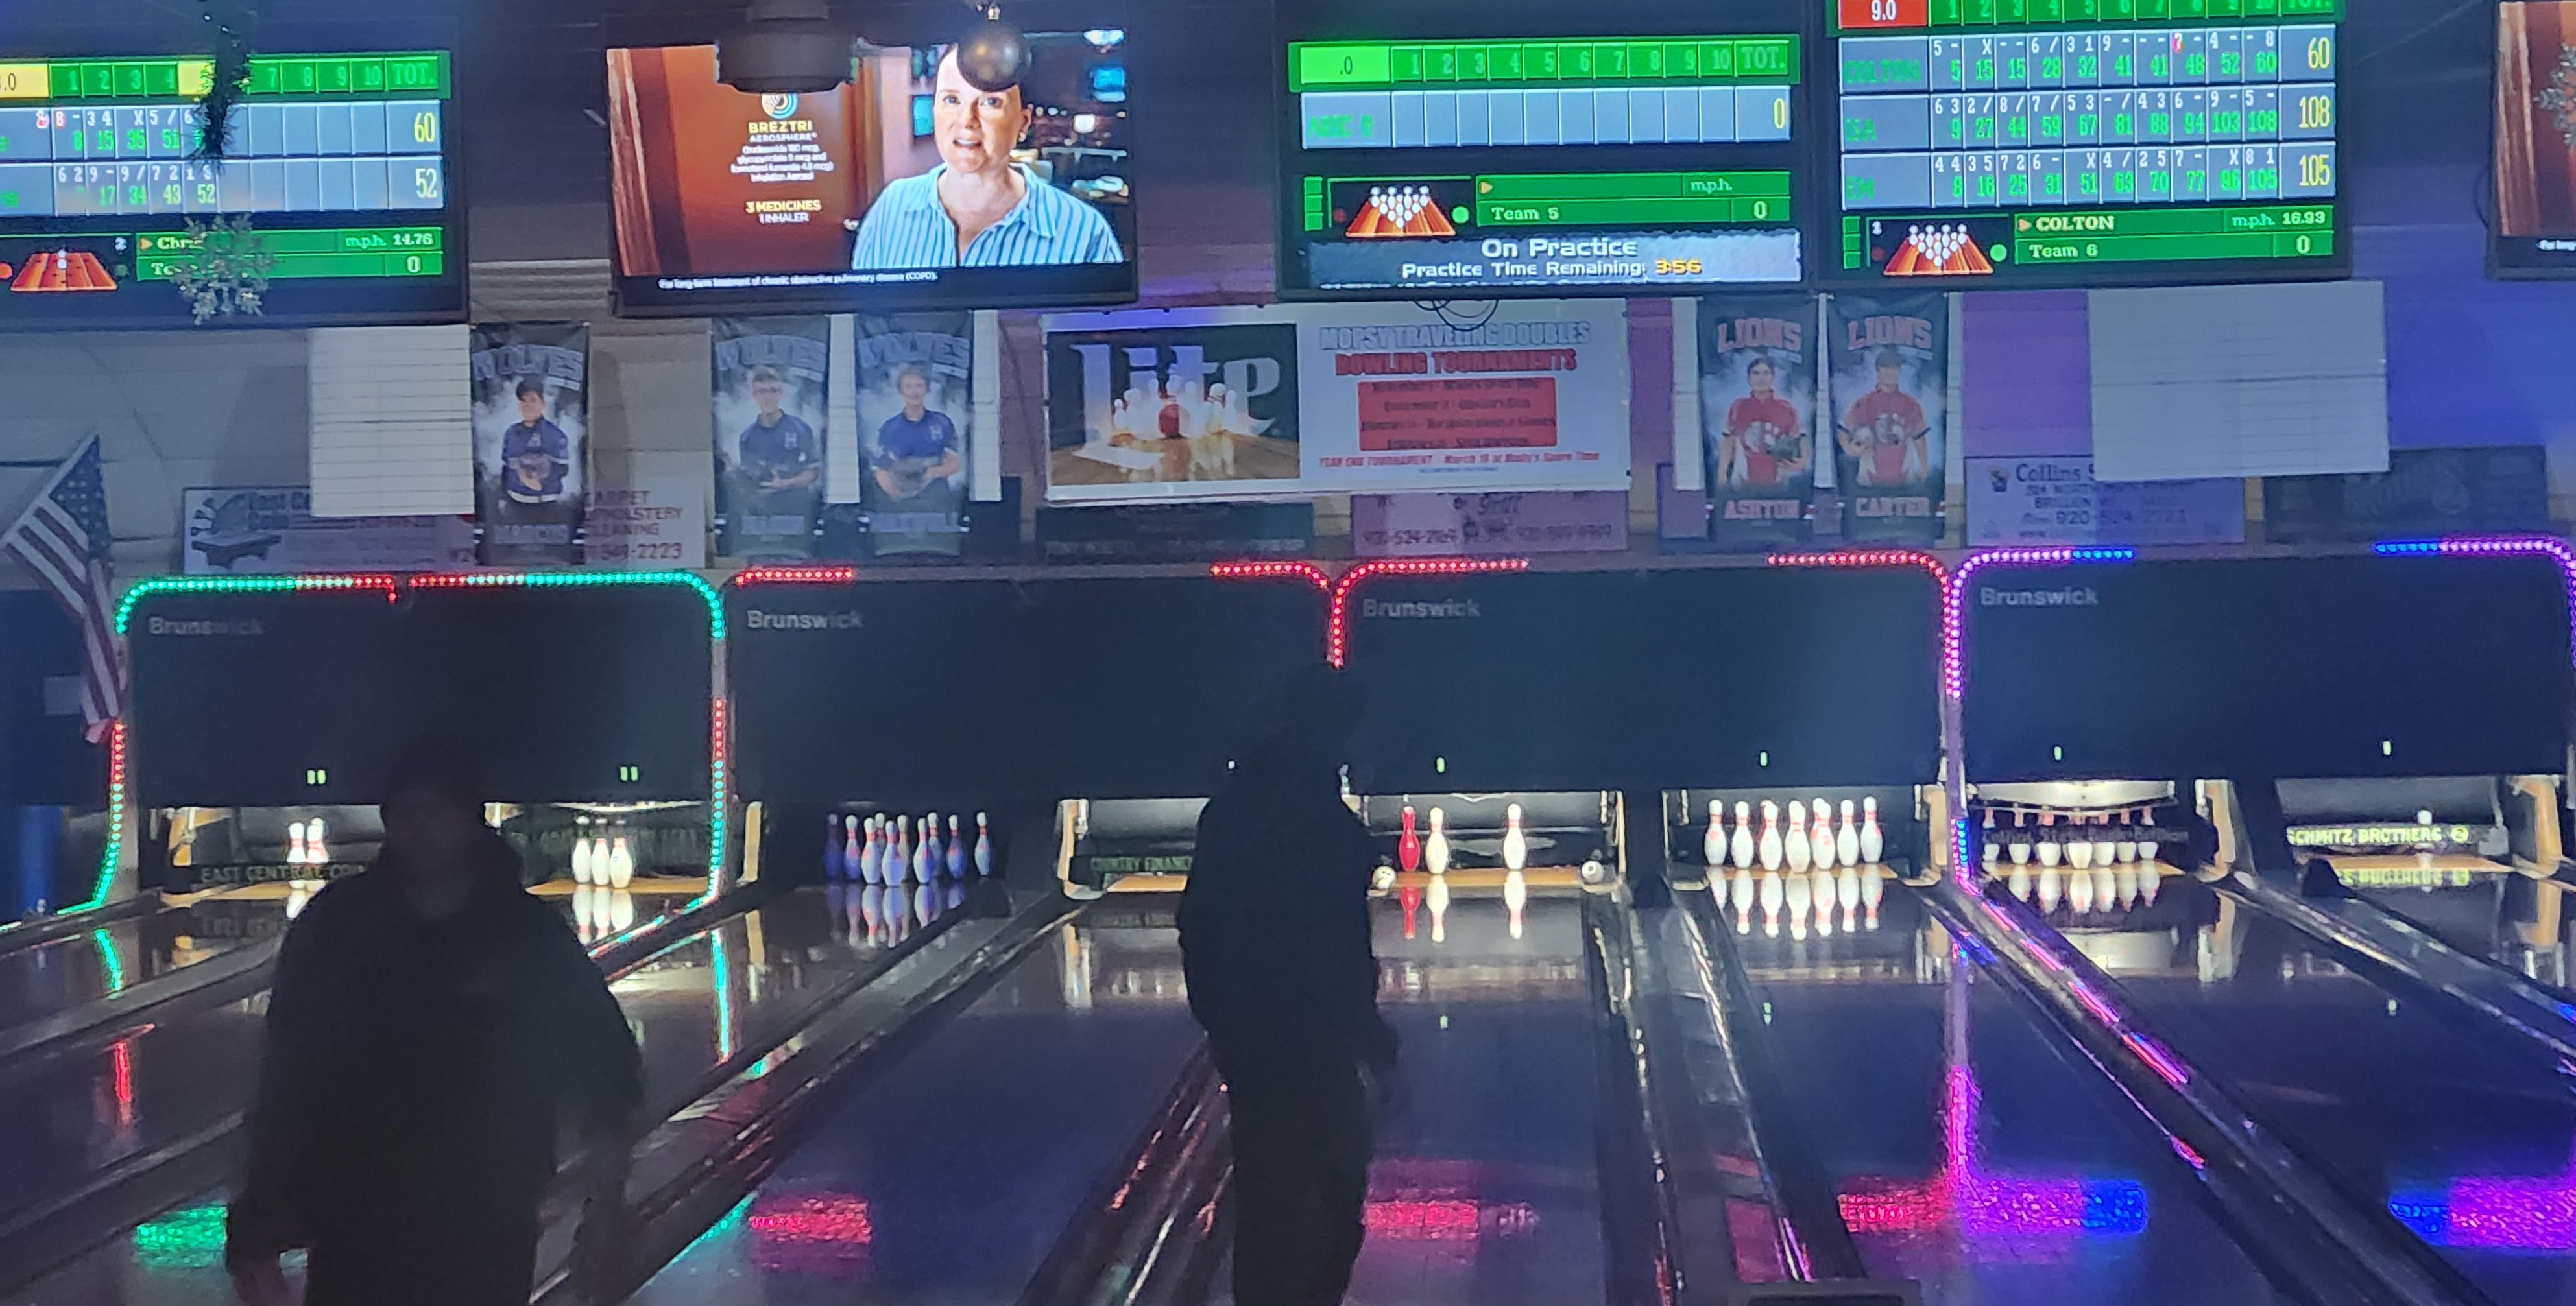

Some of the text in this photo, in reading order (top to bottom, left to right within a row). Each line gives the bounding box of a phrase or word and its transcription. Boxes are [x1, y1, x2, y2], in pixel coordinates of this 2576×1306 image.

[1871, 0, 1896, 21] 9.0
[1411, 54, 1420, 75] 1
[1442, 53, 1454, 74] 2
[1474, 53, 1486, 74] 3
[1510, 52, 1519, 73] 4
[1544, 52, 1554, 72] 5
[1578, 51, 1590, 71] 6
[1614, 51, 1624, 71] 7
[1650, 50, 1659, 71] 8
[1686, 49, 1695, 71] 9
[1713, 49, 1730, 69] 10
[1741, 46, 1786, 69] TOT.
[2307, 37, 2331, 70] 60
[1774, 97, 1786, 129] 0
[2298, 95, 2331, 128] 108
[414, 112, 436, 143] 60
[748, 120, 813, 134] BREZTRI
[2298, 154, 2331, 187] 105
[415, 168, 437, 198] 52
[746, 199, 823, 213] 3 MEDICINES
[1491, 200, 1768, 220] Team 5 0
[2036, 216, 2113, 232] COLTON
[2282, 211, 2326, 225] 16.93
[1481, 237, 1638, 258] On Practice
[2029, 236, 2310, 258] Team 6 0
[407, 255, 422, 273] 0
[1402, 259, 1703, 279] Practice Time Remaining: 3:56
[1320, 321, 1591, 350] MOPSY TRAVELING DOUBLES
[1718, 317, 1802, 353] LIONS
[1848, 315, 1932, 351] LIONS
[1335, 348, 1578, 376] BOWLING TOURNAMENTS
[1070, 344, 1281, 471] lite
[1980, 586, 2098, 606] Brunswick
[747, 610, 863, 629] Brunswick
[1363, 599, 1481, 619] Brunswick
[149, 617, 263, 635] Brunswick
[2287, 827, 2353, 846] SCHMITZ
[2357, 826, 2444, 844] BROTHERS
